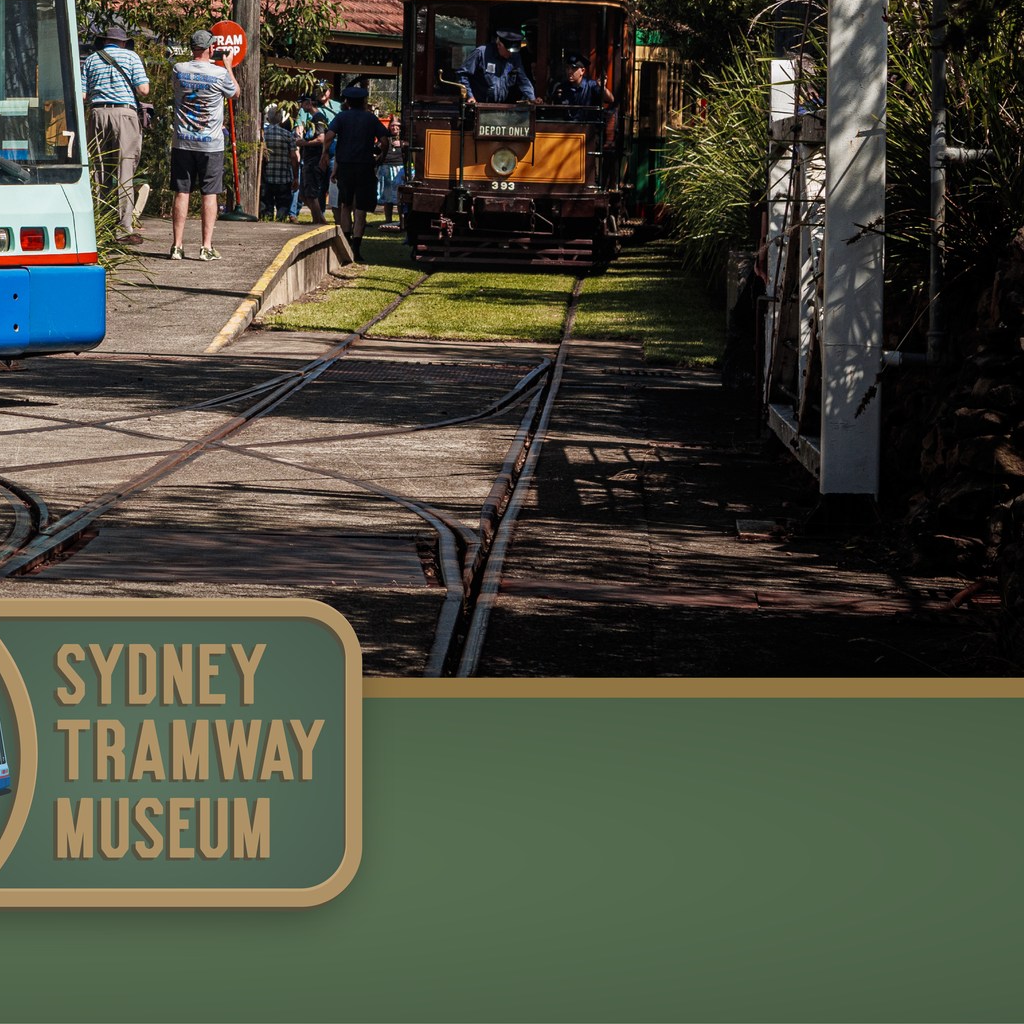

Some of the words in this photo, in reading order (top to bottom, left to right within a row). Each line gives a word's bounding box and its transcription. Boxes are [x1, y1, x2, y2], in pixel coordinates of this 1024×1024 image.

[479, 125, 507, 136] DEPOT
[509, 126, 530, 137] ONLY
[62, 130, 75, 158] 7
[491, 181, 515, 191] 393
